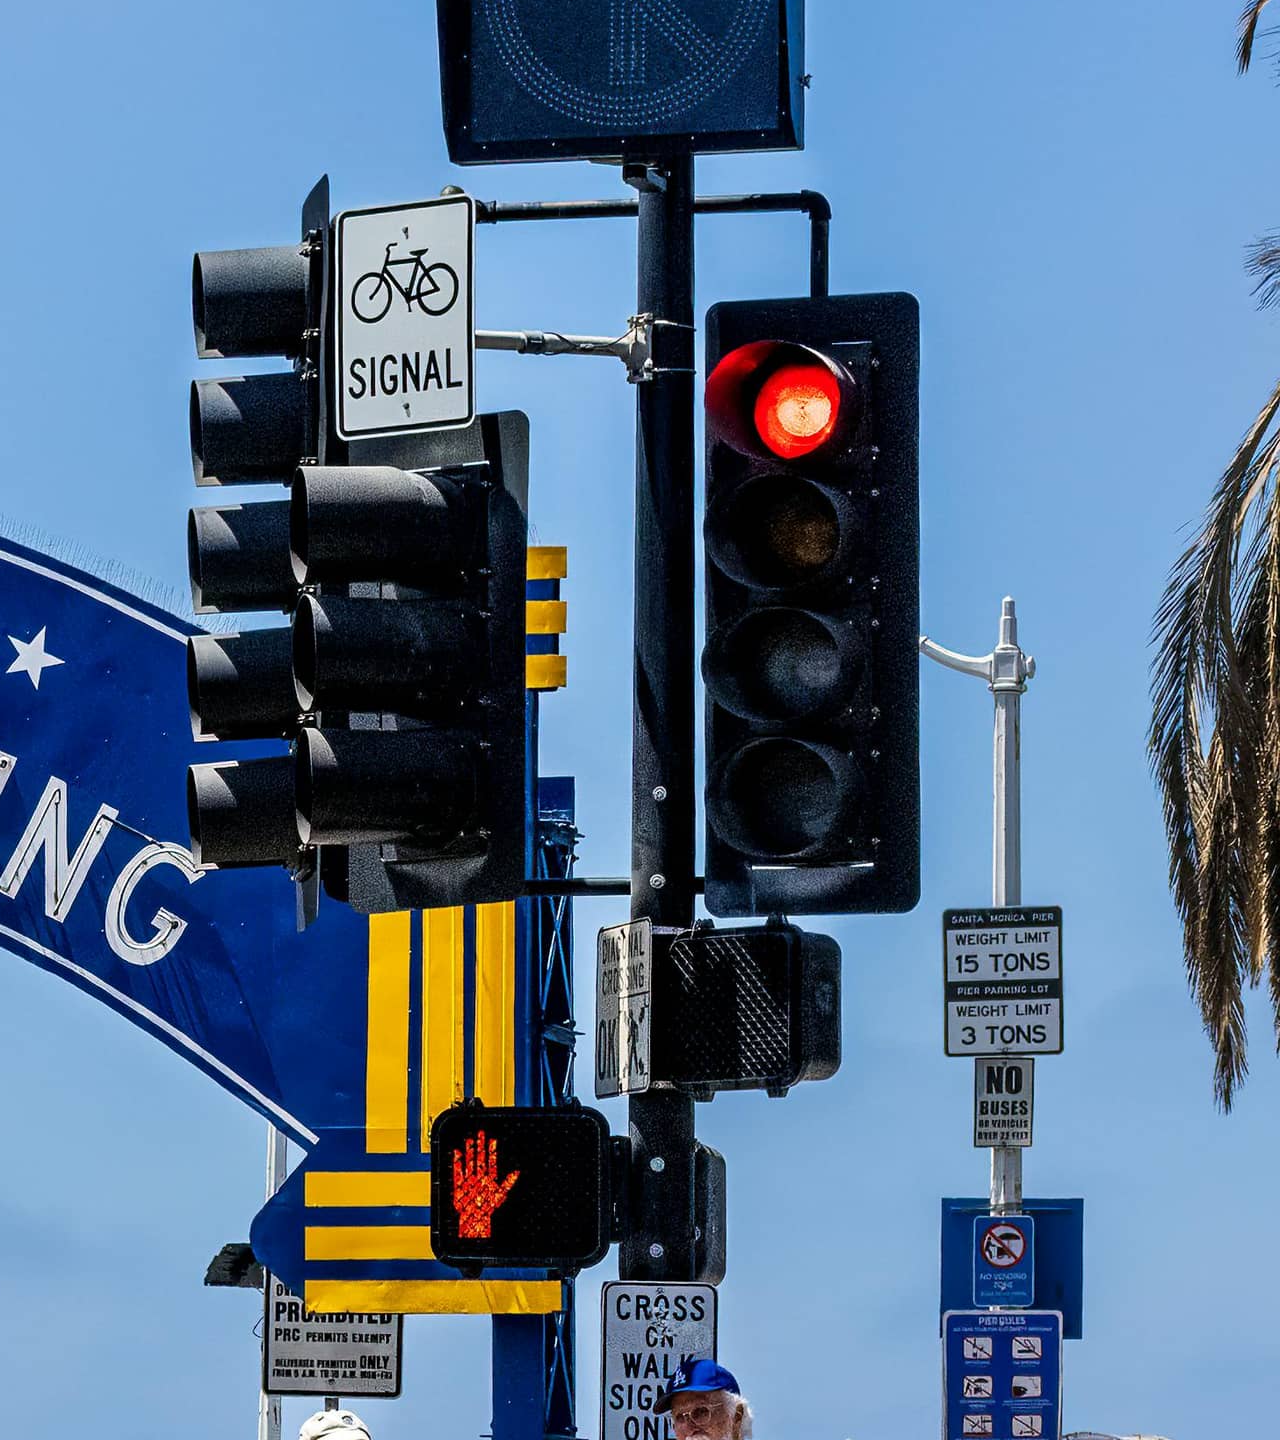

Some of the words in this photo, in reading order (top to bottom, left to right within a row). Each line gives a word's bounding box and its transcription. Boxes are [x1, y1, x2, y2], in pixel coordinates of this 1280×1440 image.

[348, 348, 463, 399] SIGNAL
[951, 914, 984, 924] SANTA
[990, 913, 1025, 923] MONICA
[1032, 912, 1054, 921] PIER
[955, 932, 1008, 945] WEIGHT
[1015, 931, 1050, 944] LIMIT
[955, 954, 979, 974] 15
[989, 952, 1050, 973] TONS
[602, 962, 645, 996] CROSSING
[957, 986, 980, 995] PIER
[984, 985, 1027, 995] PARKING
[1031, 984, 1049, 993] LOT
[956, 1005, 1008, 1017] WEIGHT
[1015, 1003, 1051, 1016] LIMIT
[961, 1026, 976, 1045] 3
[985, 1024, 1046, 1045] TONS
[597, 1018, 617, 1081] OK
[986, 1066, 1023, 1094] NO
[980, 1100, 1028, 1115] BUSES
[616, 1294, 705, 1321] CROSS
[274, 1328, 300, 1342] PRC
[306, 1332, 348, 1343] PERMITS
[352, 1333, 391, 1344] EXEMPT
[646, 1326, 673, 1348] ON
[360, 1355, 389, 1369] ONLY
